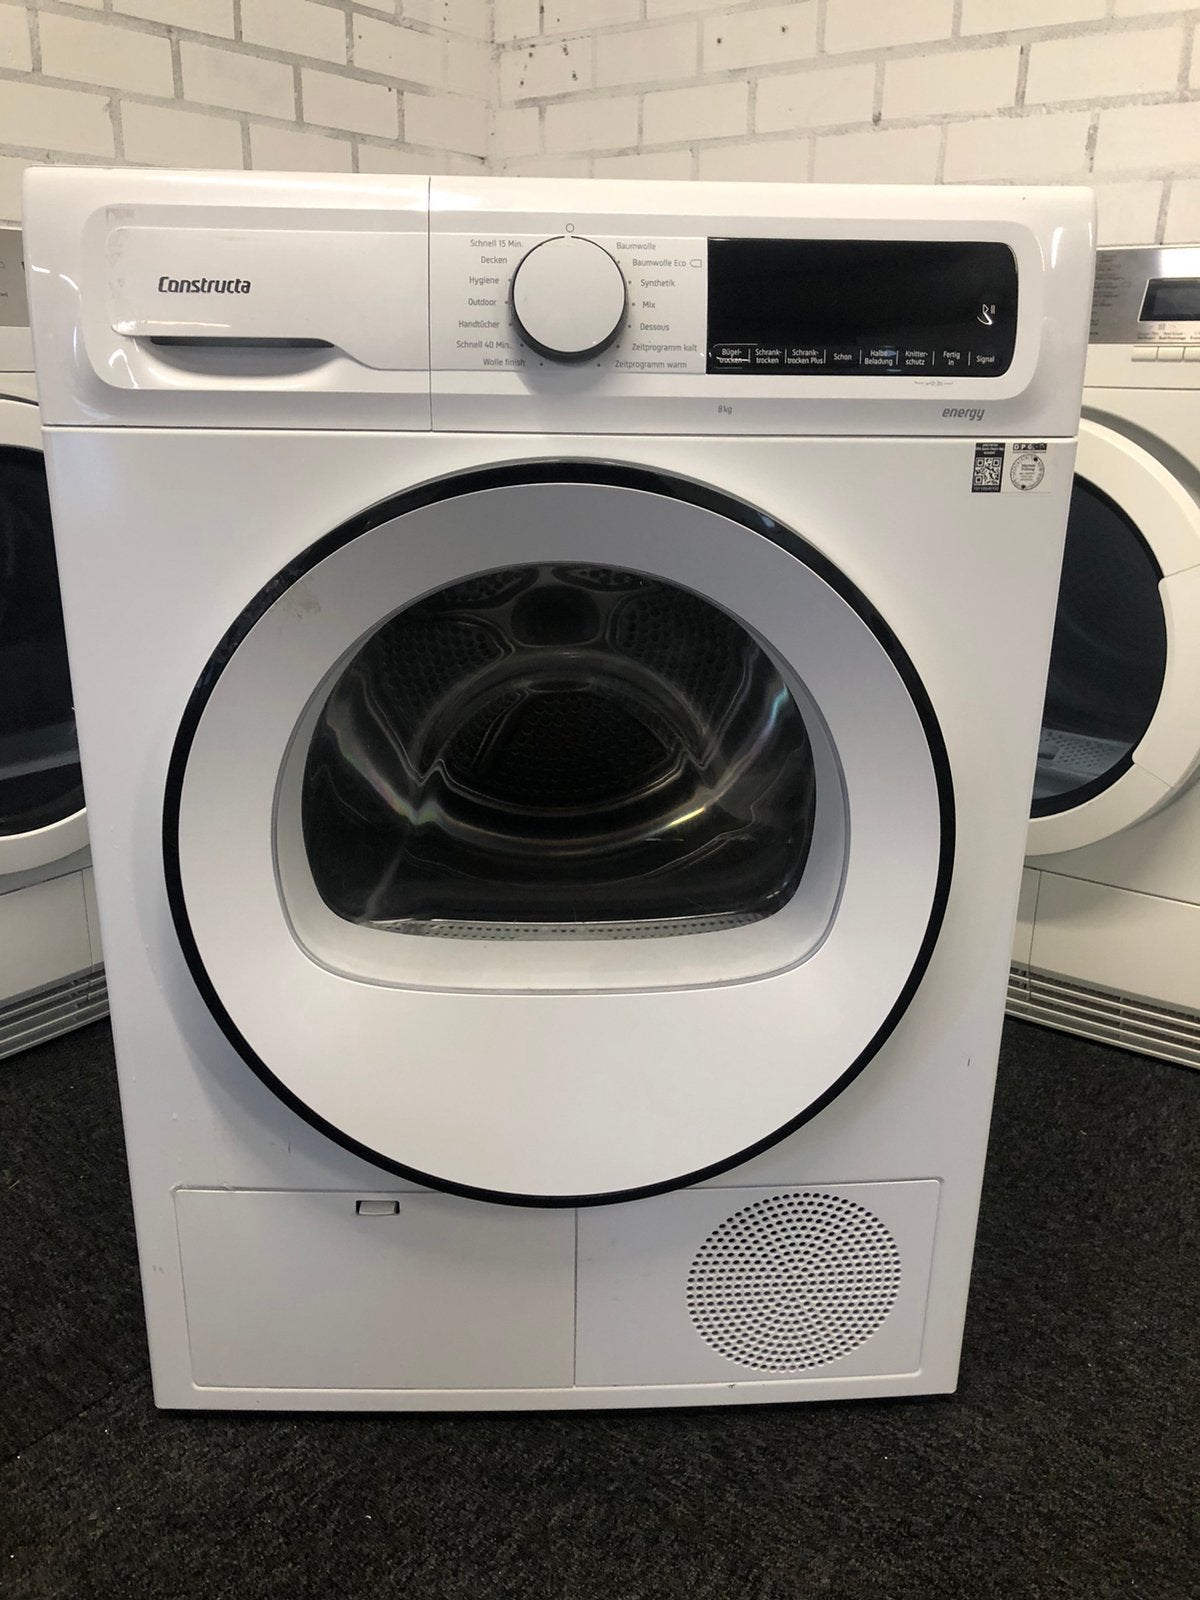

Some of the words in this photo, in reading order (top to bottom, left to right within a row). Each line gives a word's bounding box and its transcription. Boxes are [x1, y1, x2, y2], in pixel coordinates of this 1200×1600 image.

[470, 239, 497, 248] Schnell
[498, 239, 506, 247] 15
[507, 240, 524, 248] Min.
[616, 242, 657, 250] Baumwolle
[480, 256, 508, 264] Decken
[633, 259, 673, 267] Baumwolle
[674, 259, 687, 267] Eco
[469, 276, 500, 285] Hygiene
[640, 279, 675, 289] Synthetik
[158, 276, 251, 294] Constructa
[468, 298, 497, 306] Outdoor
[642, 301, 656, 309] Mix
[458, 320, 500, 328] Handtücher
[640, 323, 670, 331] Dessous
[456, 340, 483, 349] Schnell
[484, 341, 494, 349] 40
[495, 341, 512, 349] Min.
[632, 343, 682, 353] Zeitprogramm
[683, 344, 697, 352] kalt
[722, 348, 742, 357] Bügel-
[943, 351, 961, 359] Fertig
[483, 358, 503, 366] Wolle
[504, 358, 526, 366] finish
[864, 358, 893, 366] Beladung
[976, 355, 995, 363] Signal
[615, 360, 665, 370] Zeitprogramm
[723, 405, 733, 415] kg
[942, 408, 985, 421] energy
